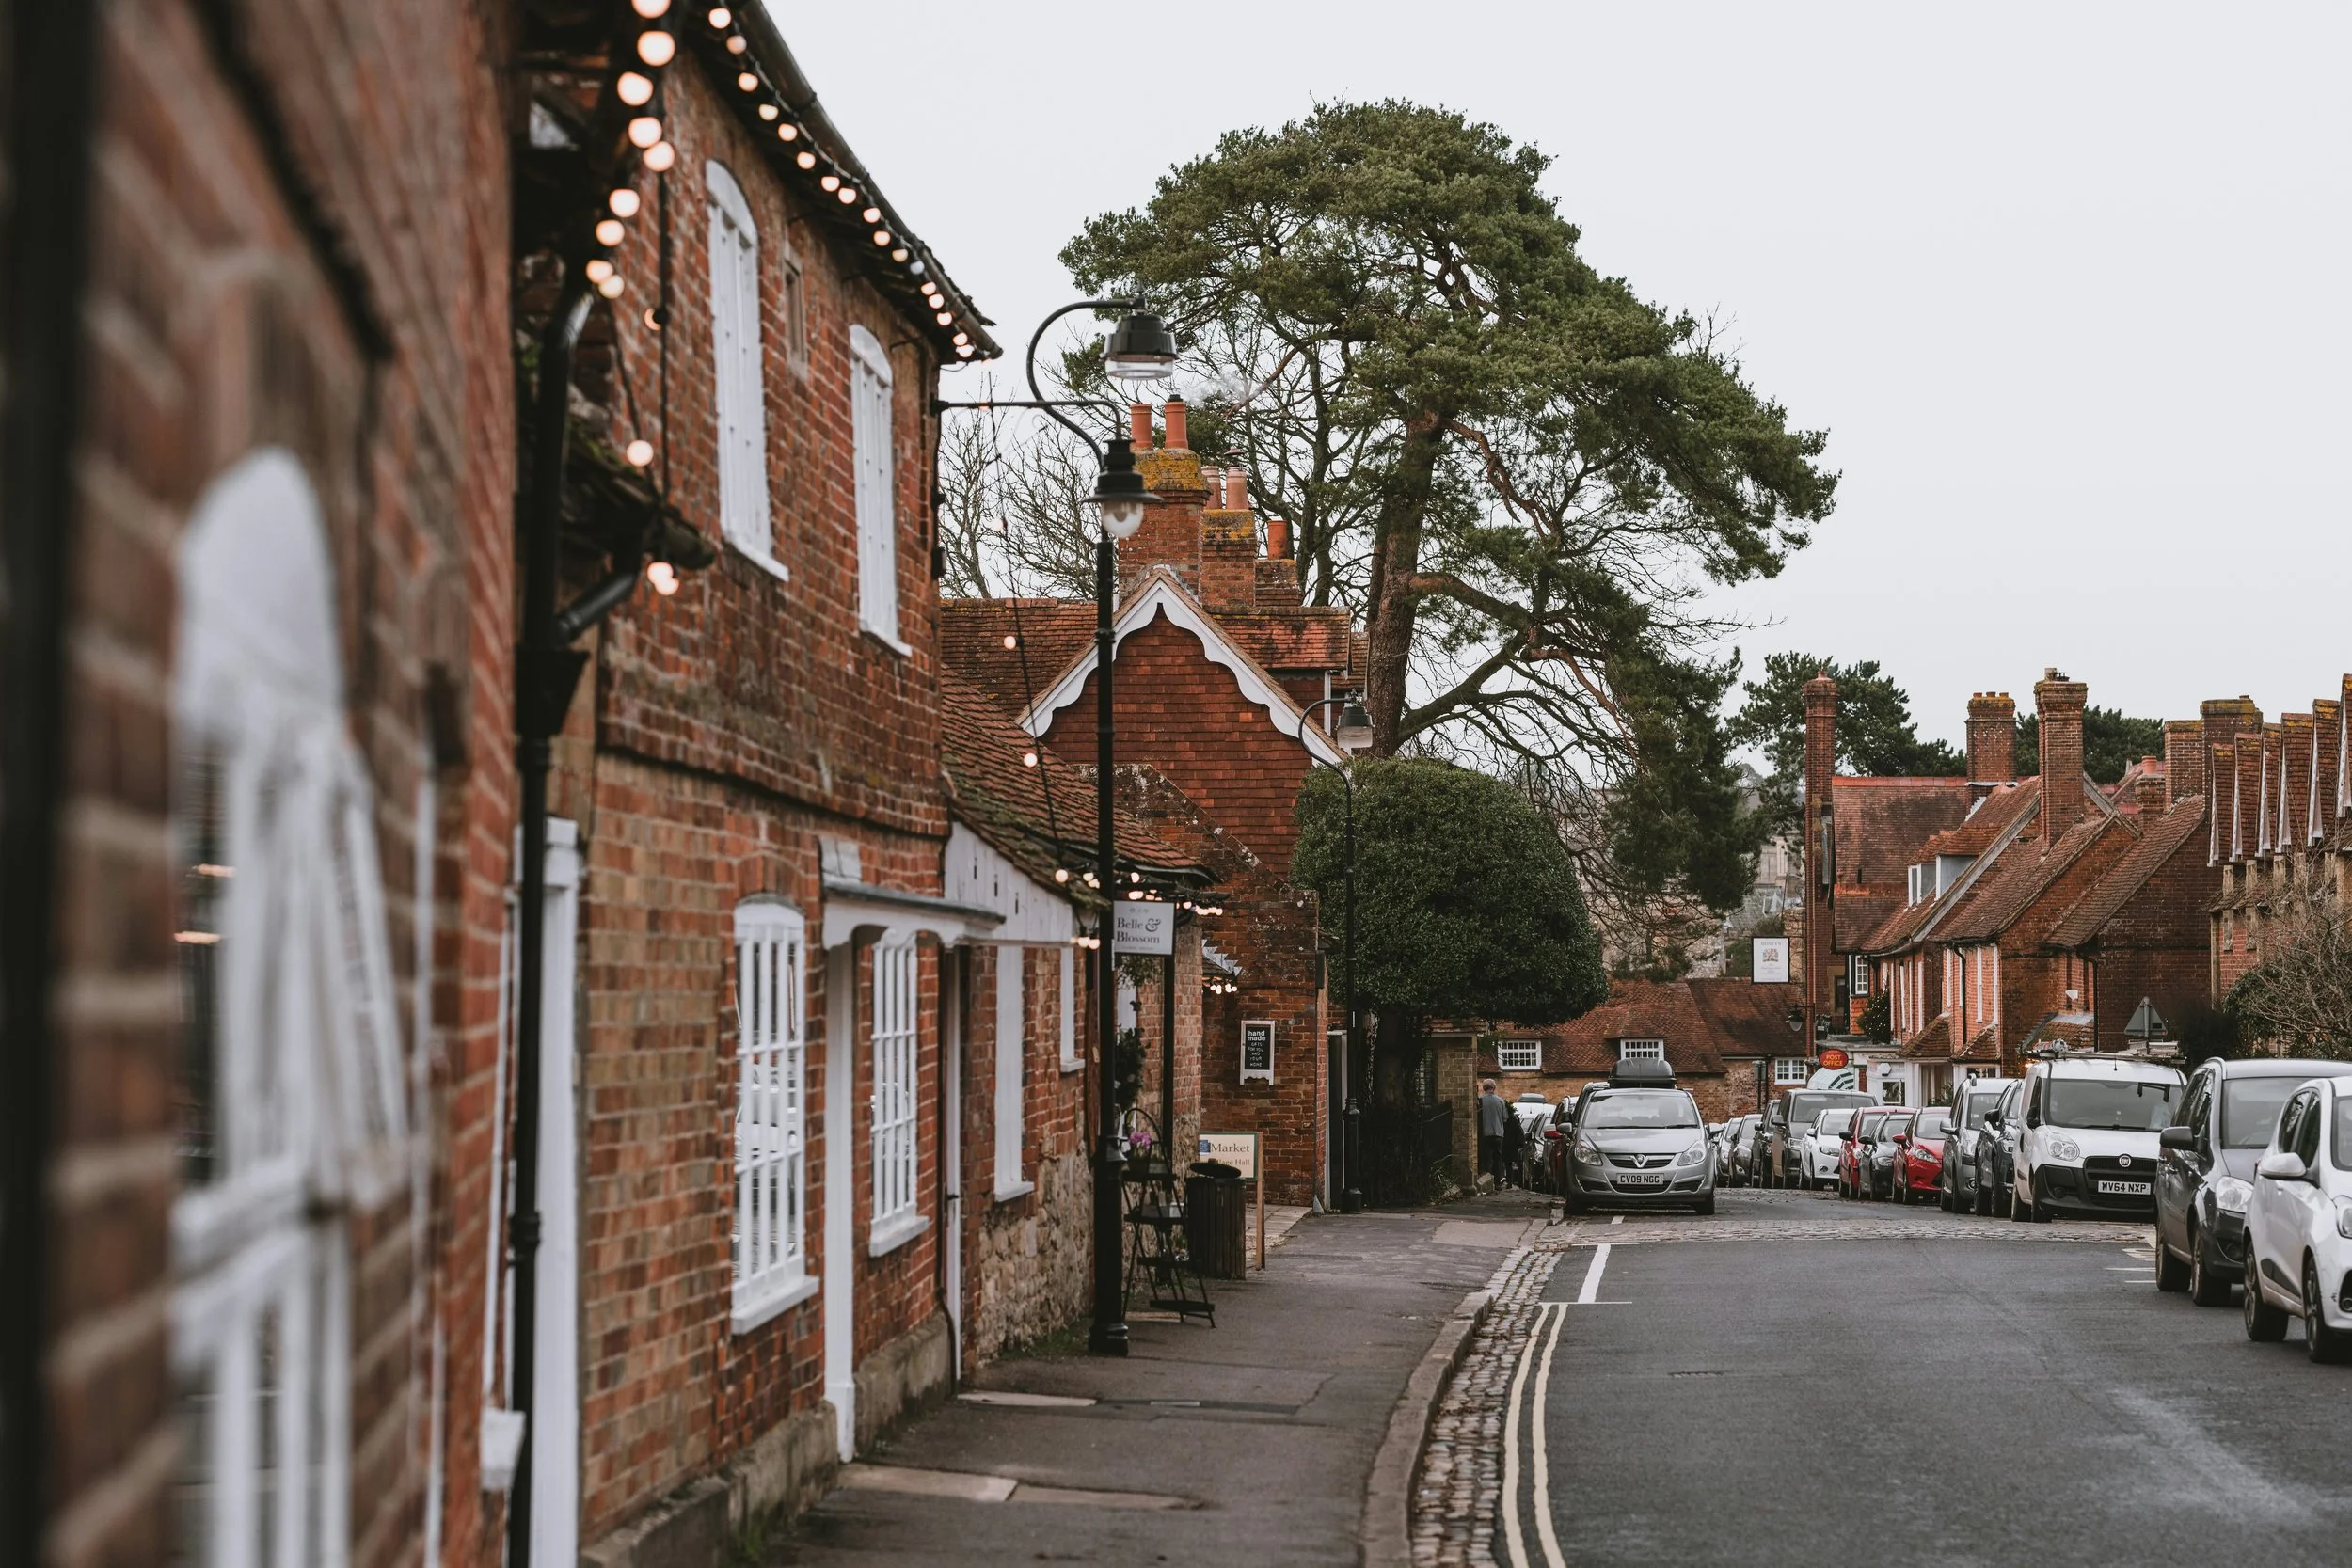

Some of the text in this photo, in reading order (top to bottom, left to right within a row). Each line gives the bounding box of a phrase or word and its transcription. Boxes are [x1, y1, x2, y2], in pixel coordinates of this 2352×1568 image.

[1117, 917, 1161, 932] Belle &
[1117, 930, 1160, 943] Blossom
[1211, 1143, 1250, 1153] Market
[1620, 1175, 1660, 1183] CV09 NGG
[2102, 1181, 2147, 1193] WV64 NXP
